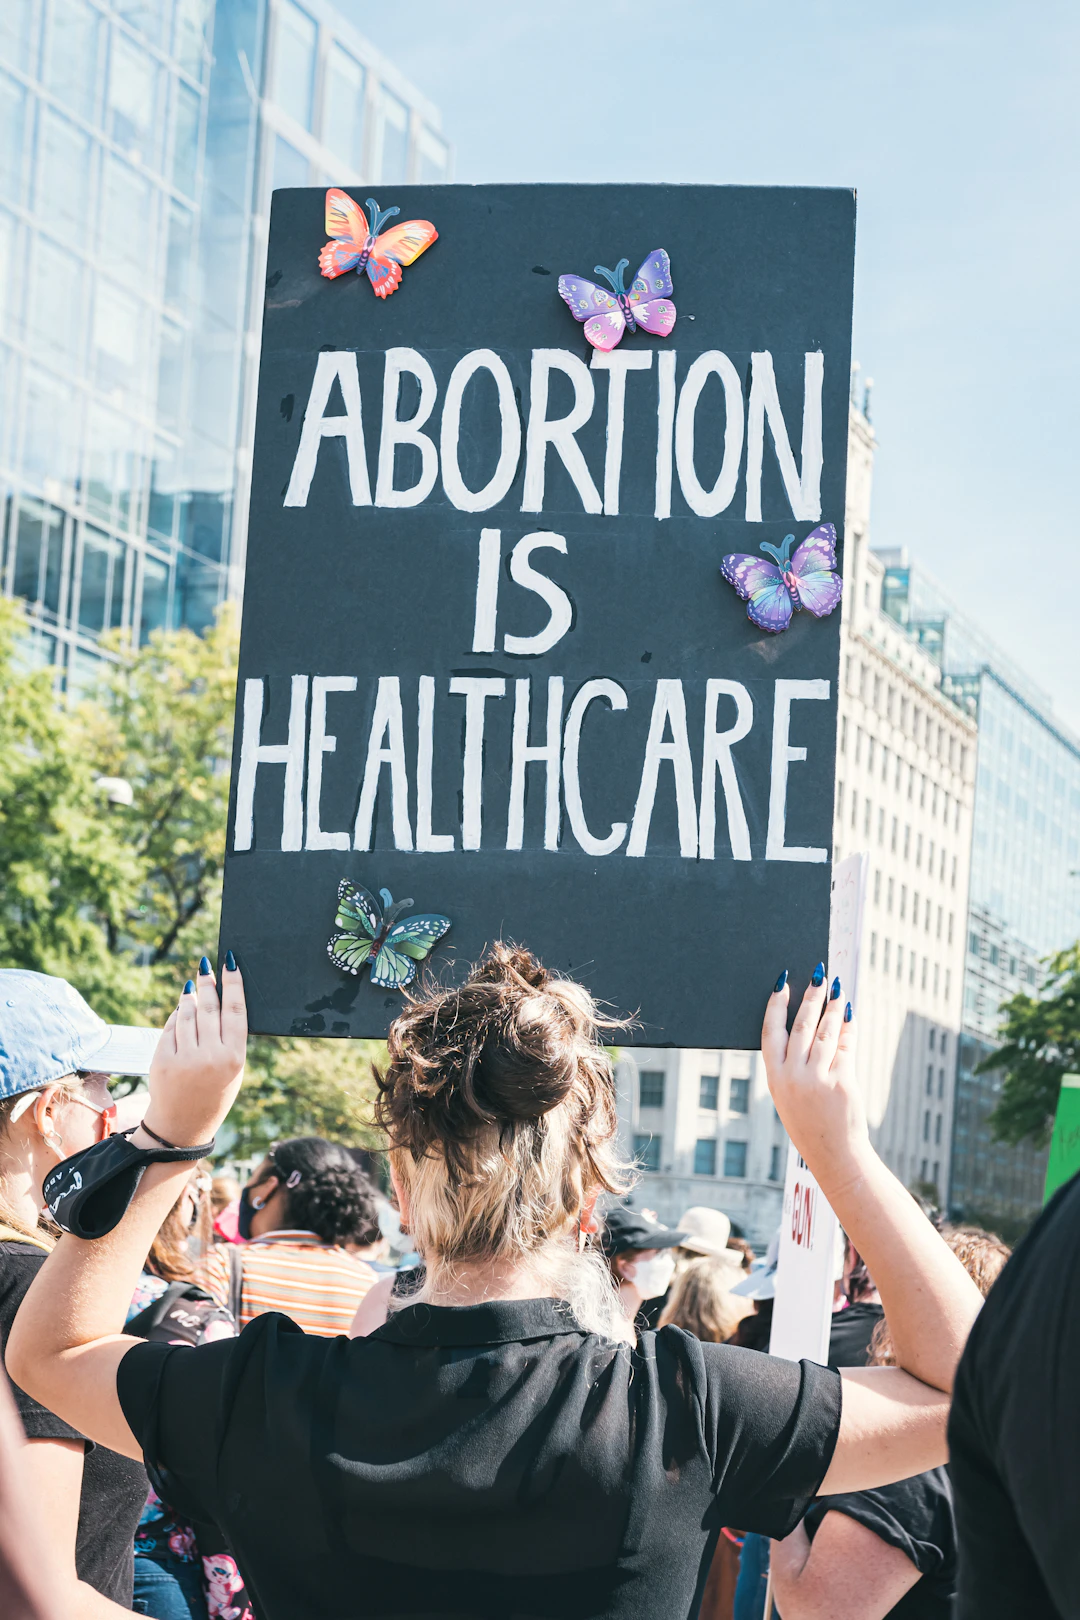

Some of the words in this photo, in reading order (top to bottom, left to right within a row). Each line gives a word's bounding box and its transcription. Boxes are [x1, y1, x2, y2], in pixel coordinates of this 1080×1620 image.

[283, 347, 825, 522] ABORTION
[472, 528, 573, 655] IS
[233, 674, 831, 863] HEALTHCARE
